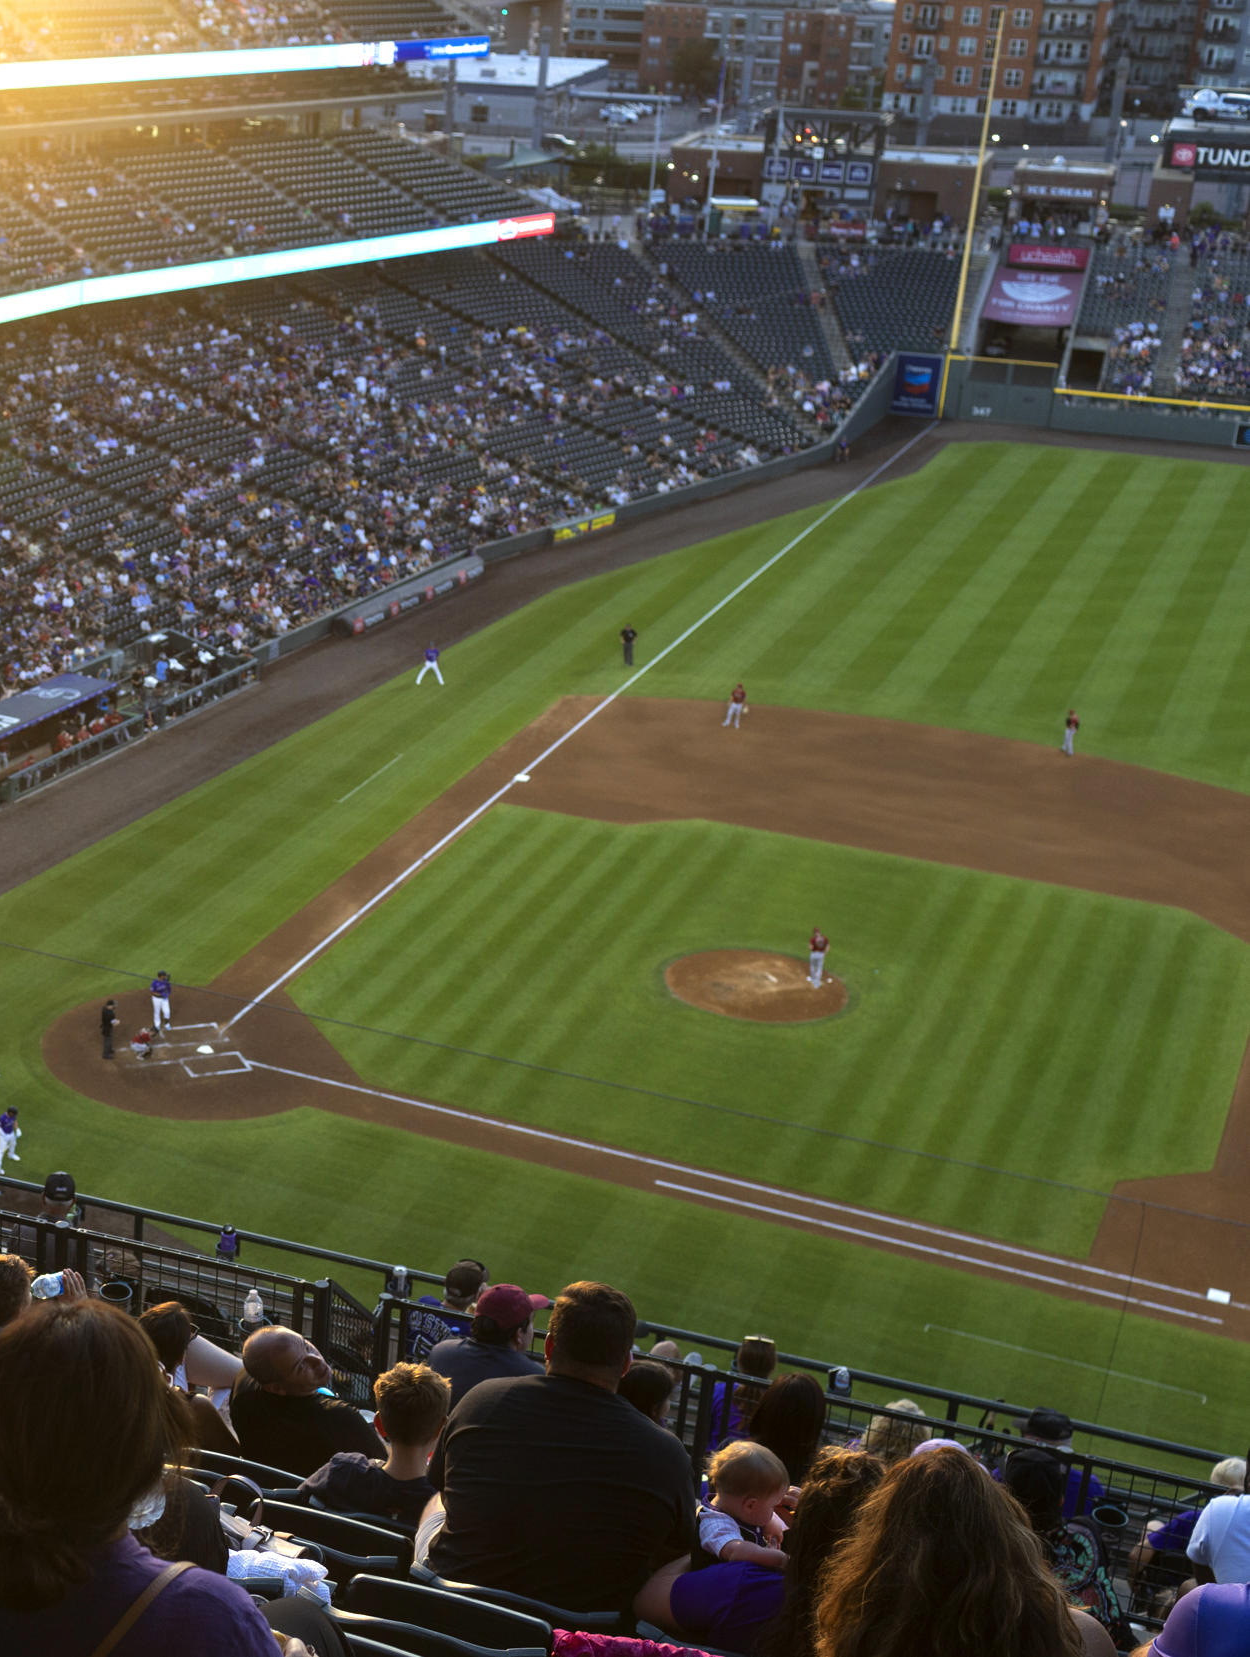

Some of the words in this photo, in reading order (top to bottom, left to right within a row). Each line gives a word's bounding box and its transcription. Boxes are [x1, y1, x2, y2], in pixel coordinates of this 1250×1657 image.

[1197, 146, 1250, 168] TUND
[1027, 186, 1048, 195] ICE
[1050, 187, 1093, 198] CREAM
[1020, 248, 1077, 265] uchealth
